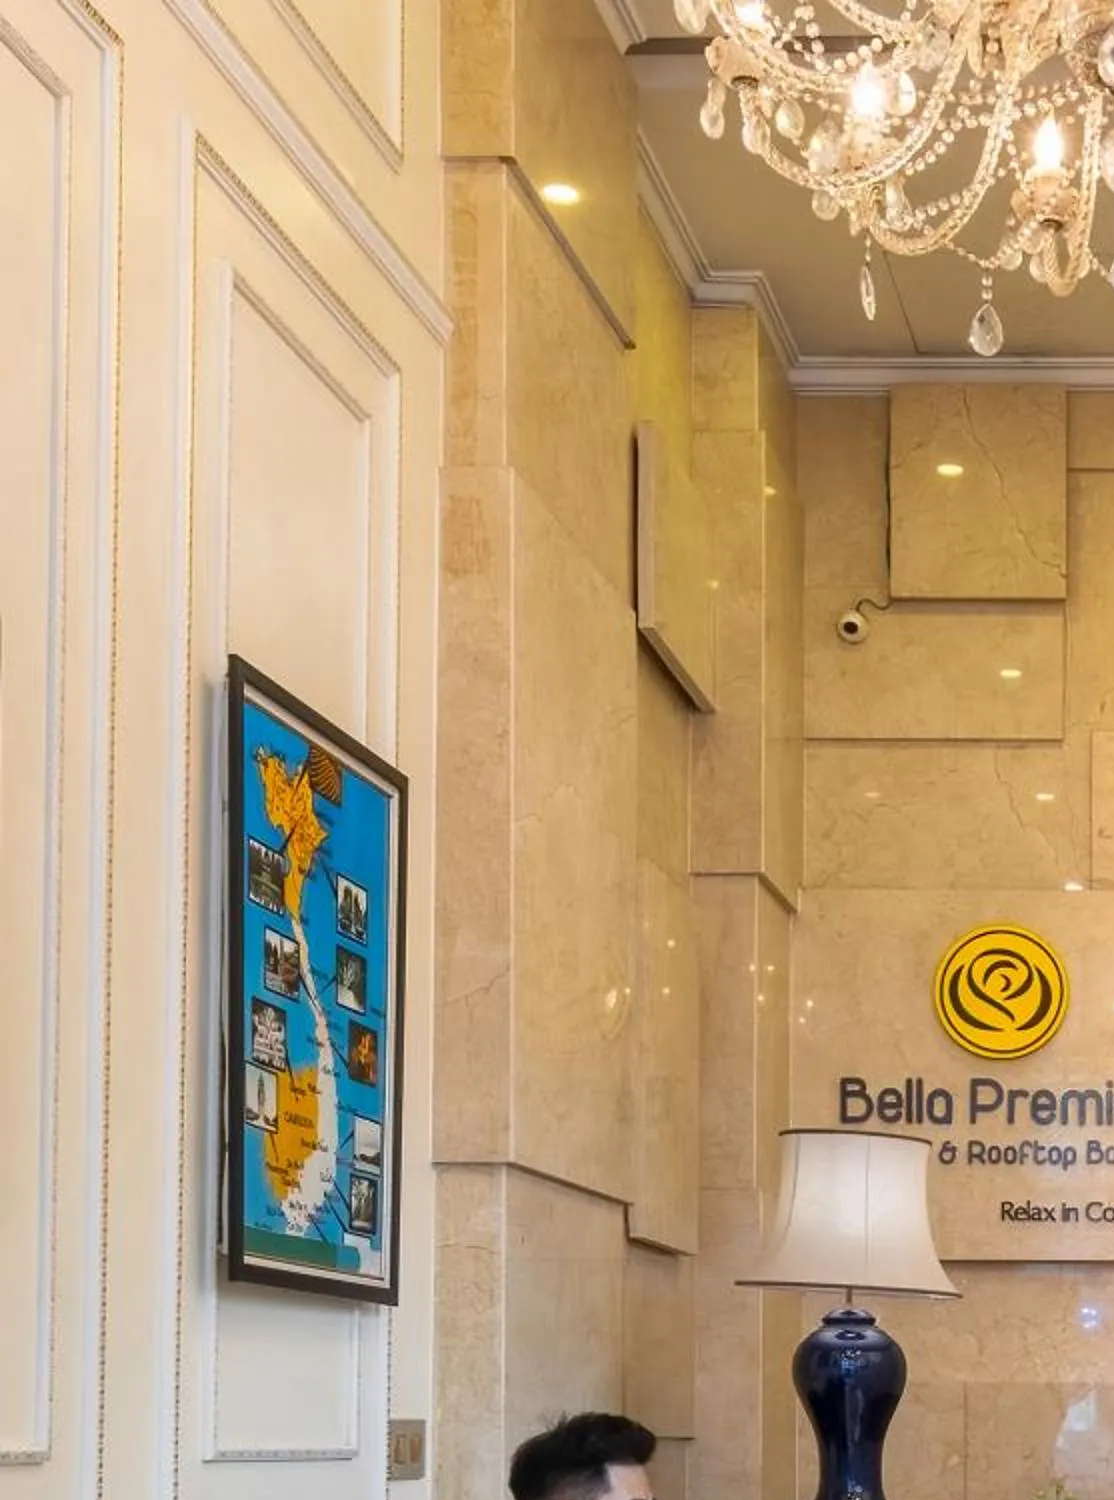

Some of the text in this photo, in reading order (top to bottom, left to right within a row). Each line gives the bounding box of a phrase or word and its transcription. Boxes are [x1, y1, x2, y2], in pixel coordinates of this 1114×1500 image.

[840, 1077, 953, 1125] Bella
[938, 1140, 957, 1166] &
[966, 1140, 1078, 1171] Rooftop
[1000, 1200, 1057, 1222] Relax
